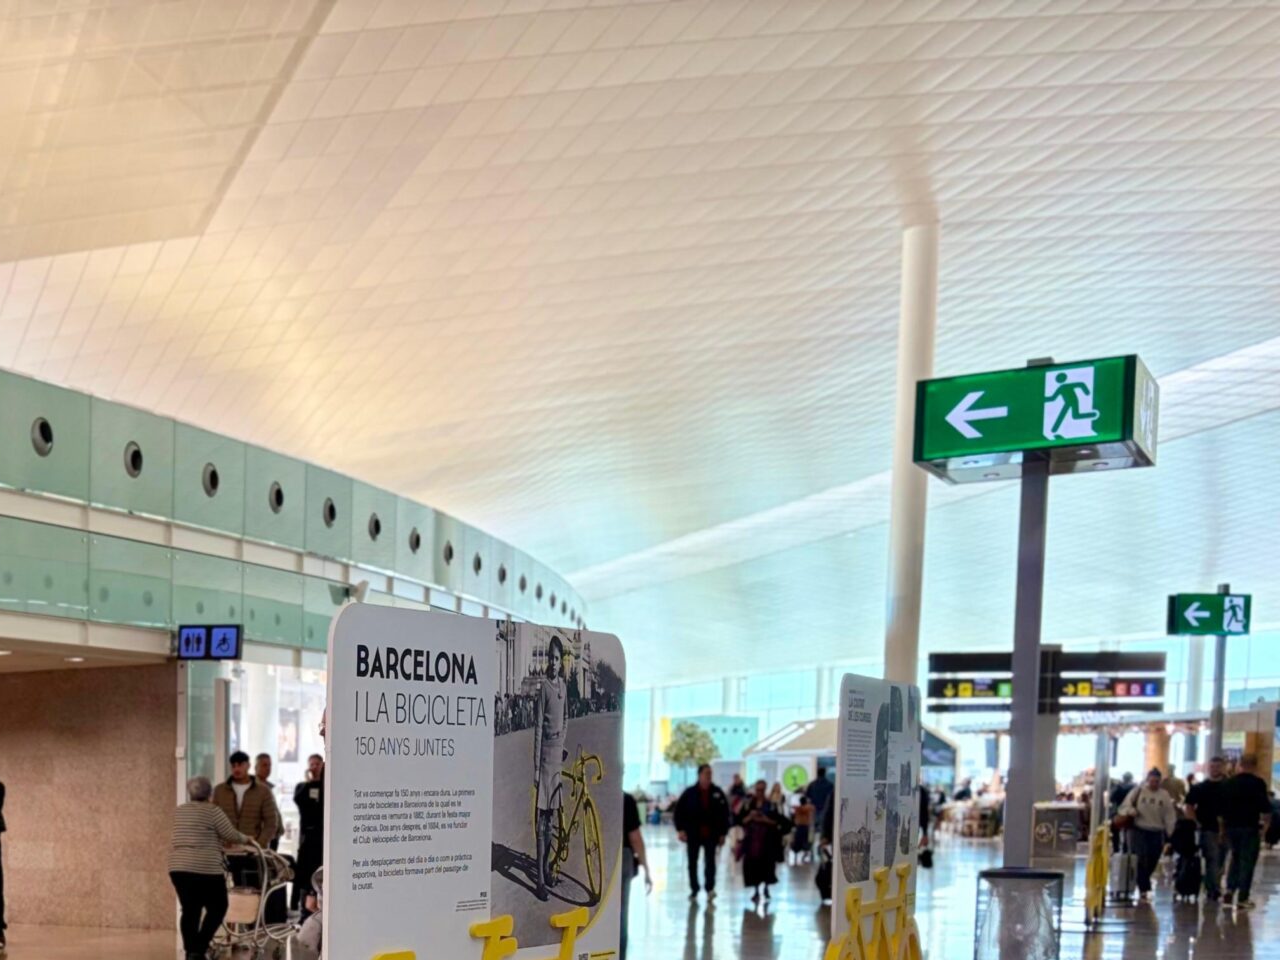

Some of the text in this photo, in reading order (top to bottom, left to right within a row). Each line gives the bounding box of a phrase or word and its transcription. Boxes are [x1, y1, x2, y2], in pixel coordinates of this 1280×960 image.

[356, 644, 478, 685] BARCELONA
[365, 691, 390, 723] LA
[395, 692, 487, 727] BICICLETA
[355, 736, 455, 757] 150 ANYS JUNTES
